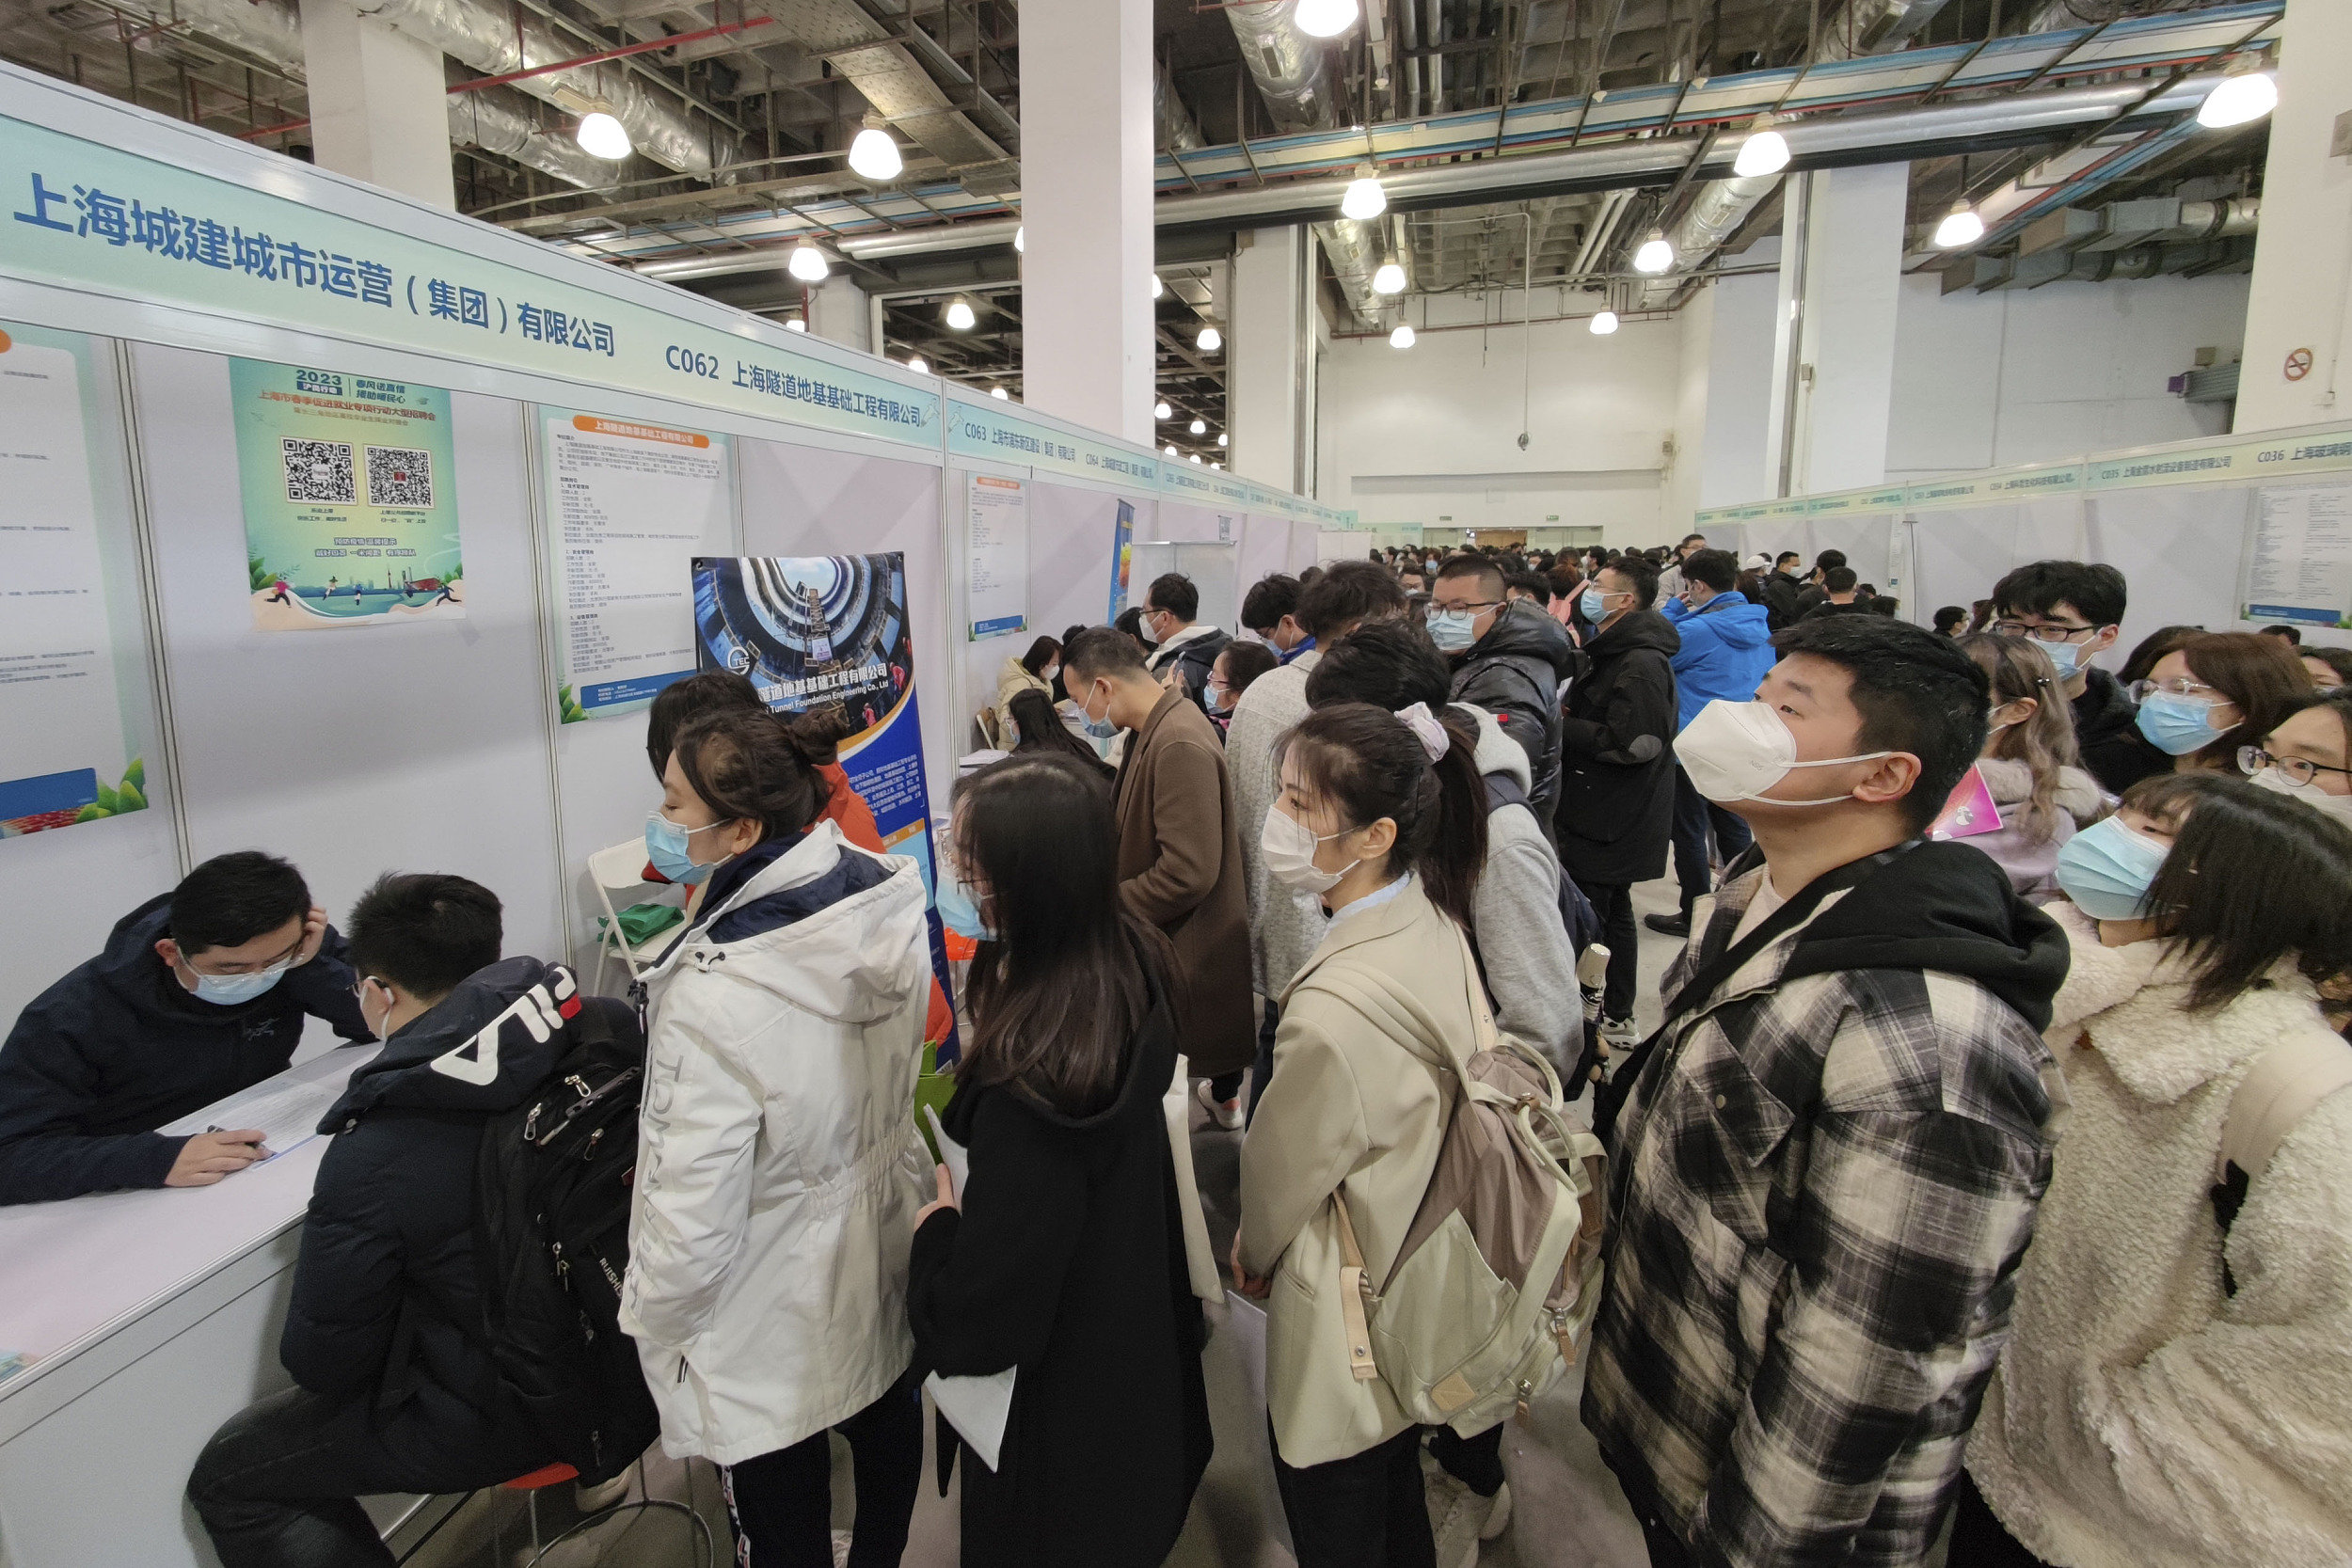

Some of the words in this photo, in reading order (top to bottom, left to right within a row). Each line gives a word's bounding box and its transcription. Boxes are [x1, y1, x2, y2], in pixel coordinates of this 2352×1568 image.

[13, 172, 614, 356] 上海城建城市运营（集团）有限公司
[296, 369, 342, 386] 2023
[665, 345, 720, 380] C062
[732, 360, 921, 427] 上海隧道地基基础工程有限公司
[965, 422, 987, 441] C063
[2258, 450, 2285, 463] C036
[770, 703, 794, 714] Tunnel
[795, 693, 832, 707] Foundation
[833, 686, 867, 700] Engineering
